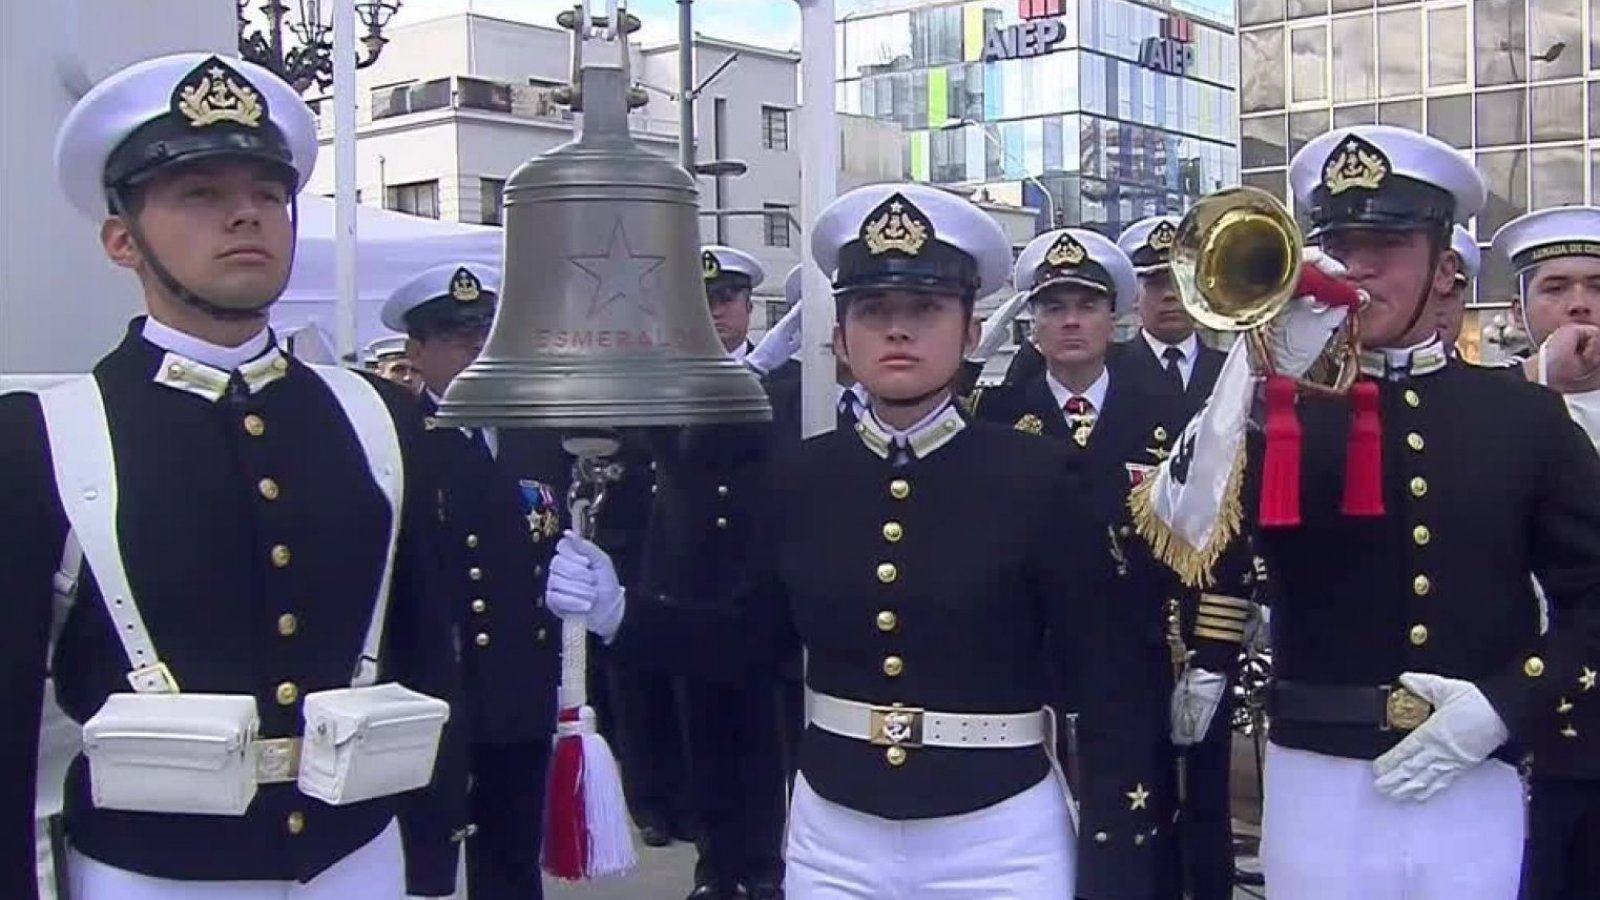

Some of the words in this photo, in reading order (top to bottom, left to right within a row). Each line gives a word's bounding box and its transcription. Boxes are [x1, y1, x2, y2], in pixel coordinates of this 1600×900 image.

[981, 20, 1065, 60] AIEP
[1141, 38, 1194, 74] AIEP
[534, 328, 704, 350] ESMERAL
